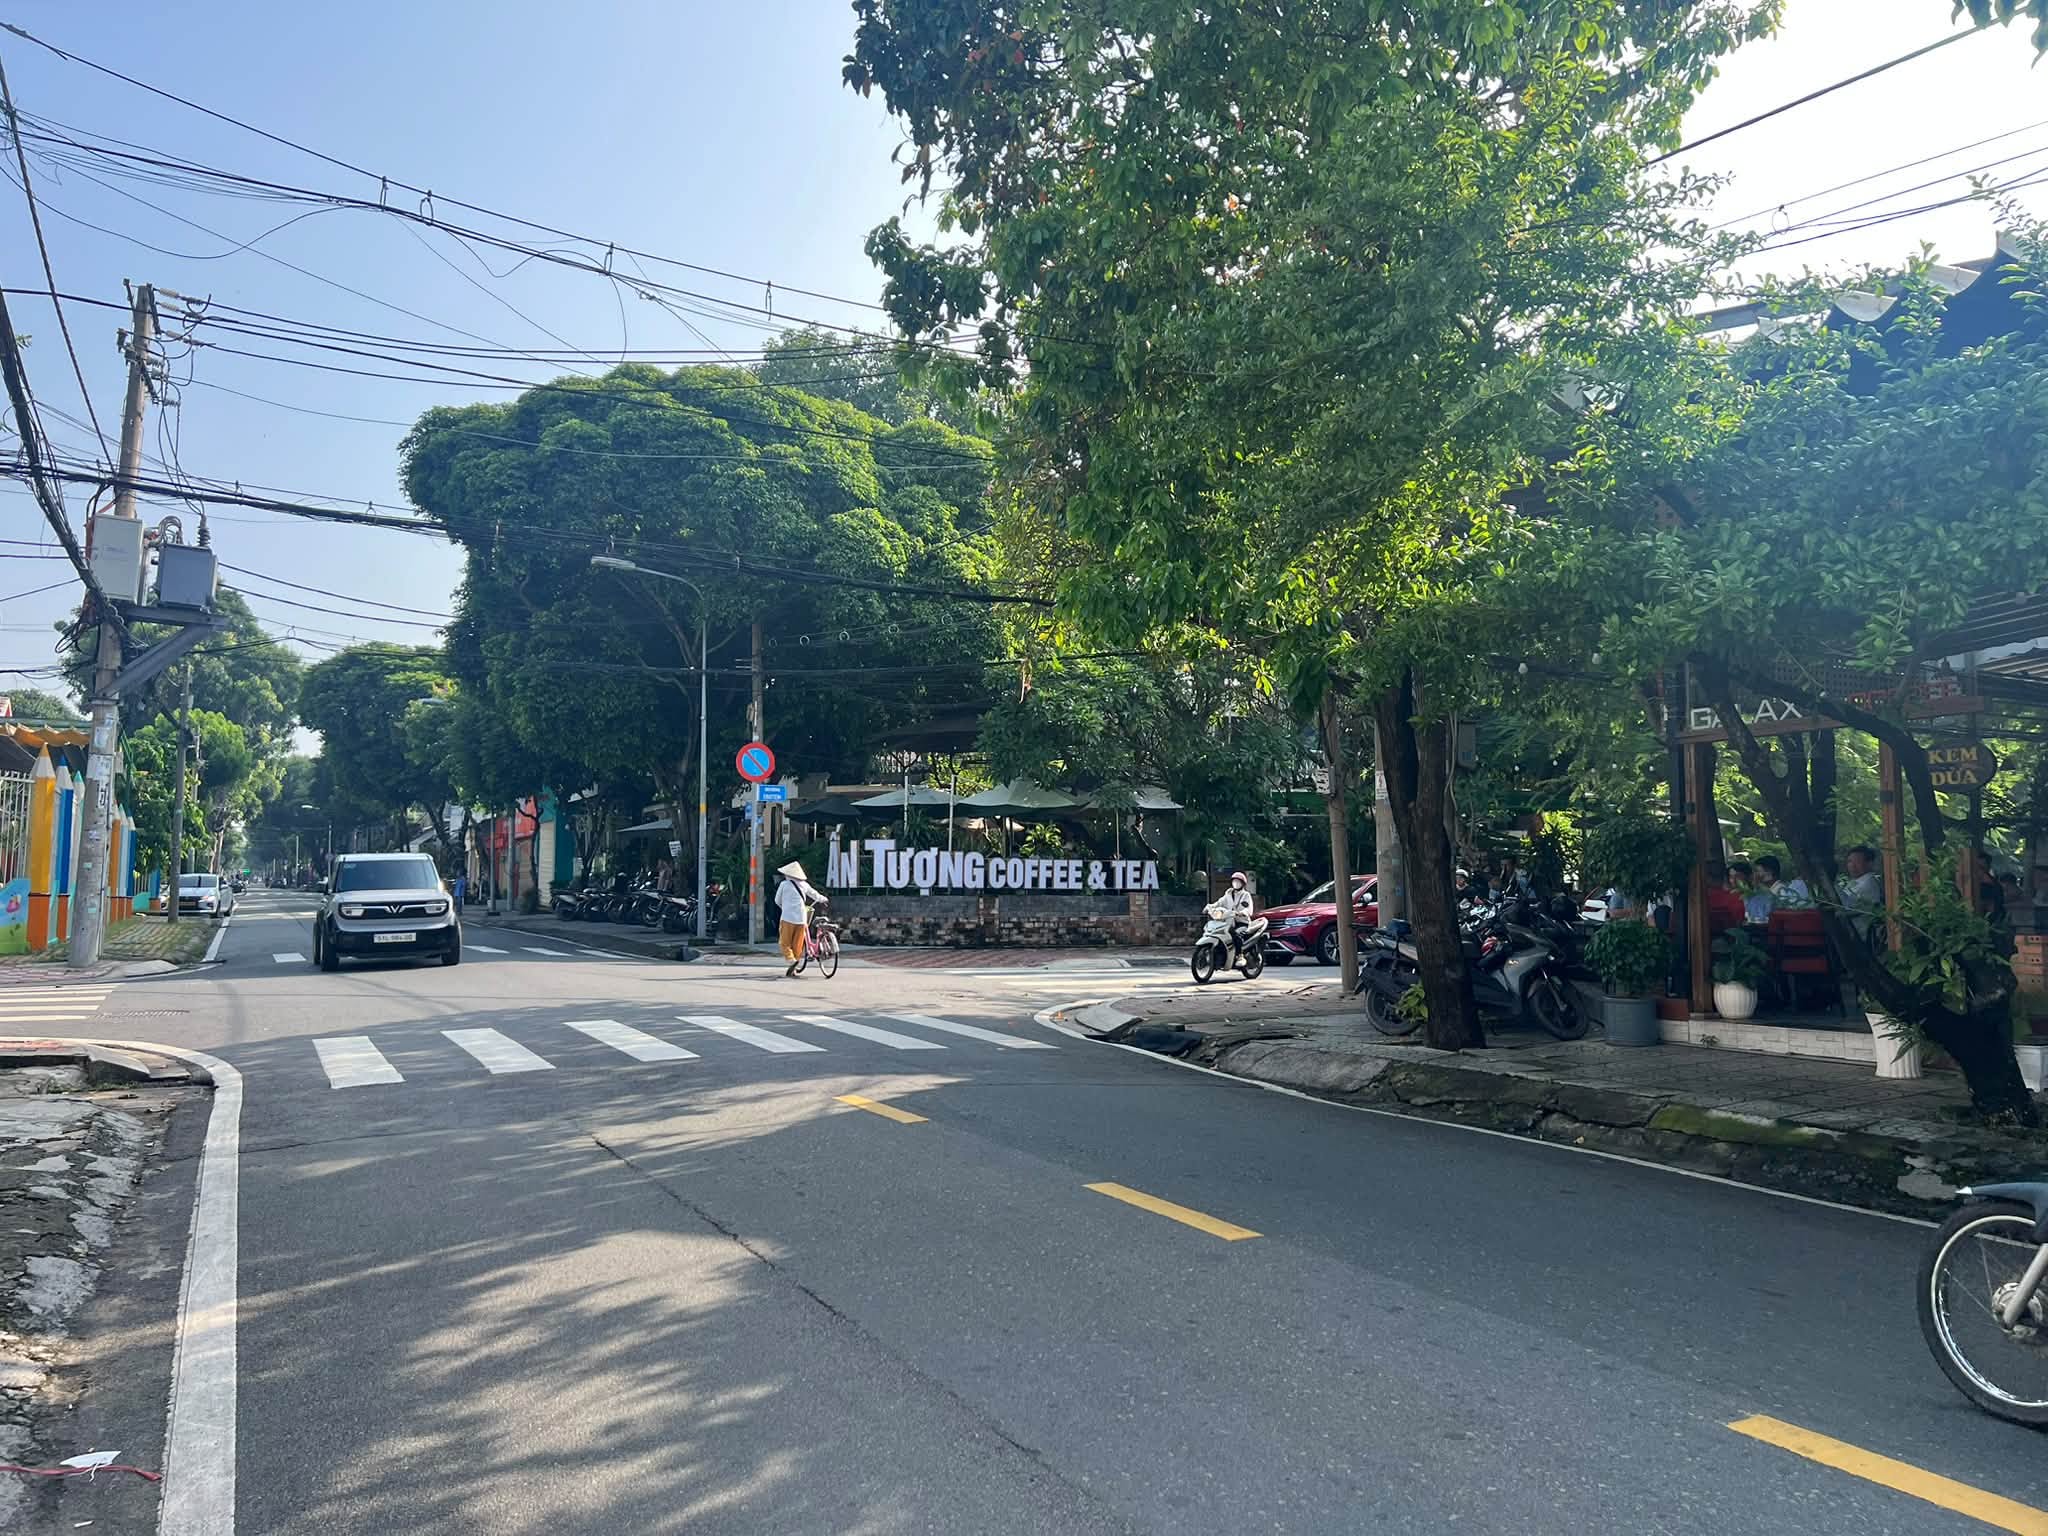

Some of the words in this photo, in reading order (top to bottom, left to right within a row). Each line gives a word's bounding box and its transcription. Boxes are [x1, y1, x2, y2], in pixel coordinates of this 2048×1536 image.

[1928, 746, 1978, 764] KEM
[865, 839, 984, 896] TƯỢNG
[988, 859, 1082, 889] COFFEE
[1087, 859, 1107, 889] &
[1111, 859, 1159, 889] TEA
